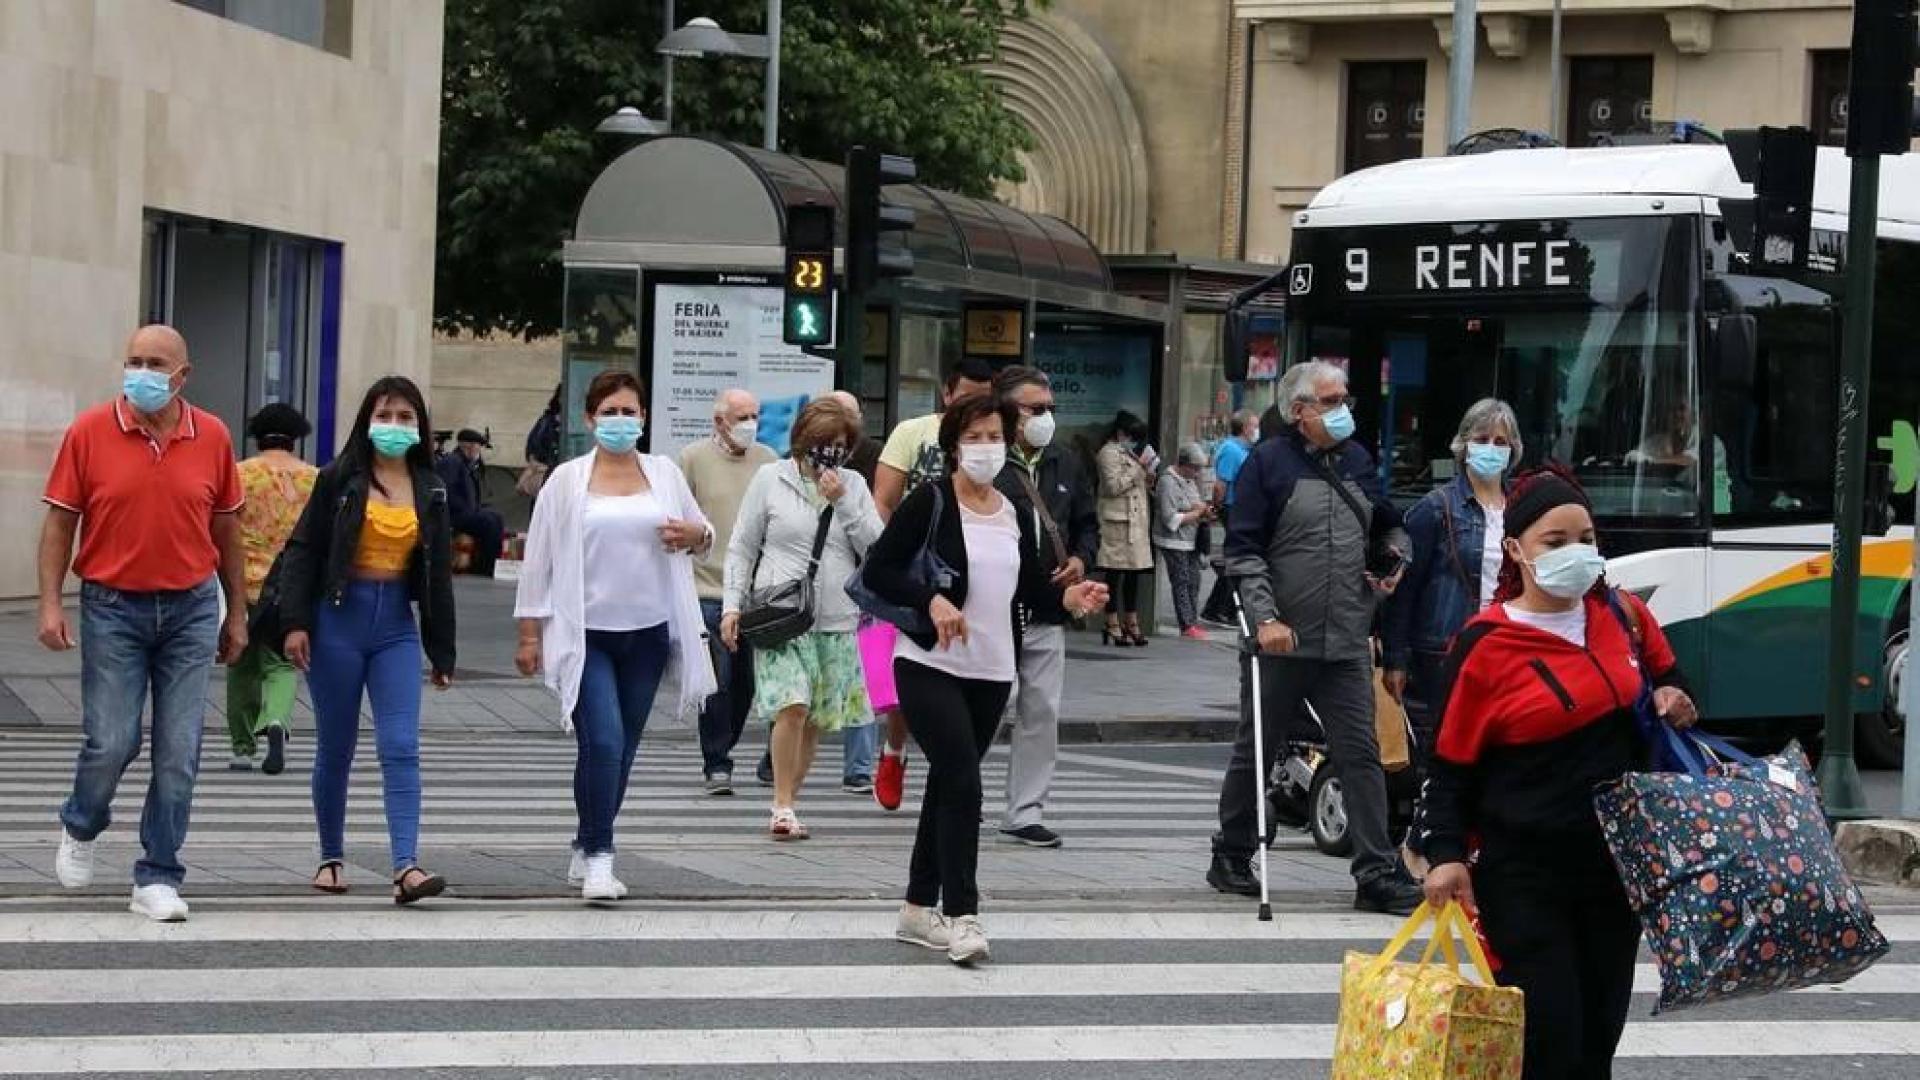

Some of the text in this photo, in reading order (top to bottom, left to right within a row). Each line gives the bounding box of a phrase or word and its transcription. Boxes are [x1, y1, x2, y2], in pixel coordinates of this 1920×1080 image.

[795, 260, 822, 288] 23
[1345, 239, 1570, 292] 9 RENFE
[674, 302, 721, 317] FERIA
